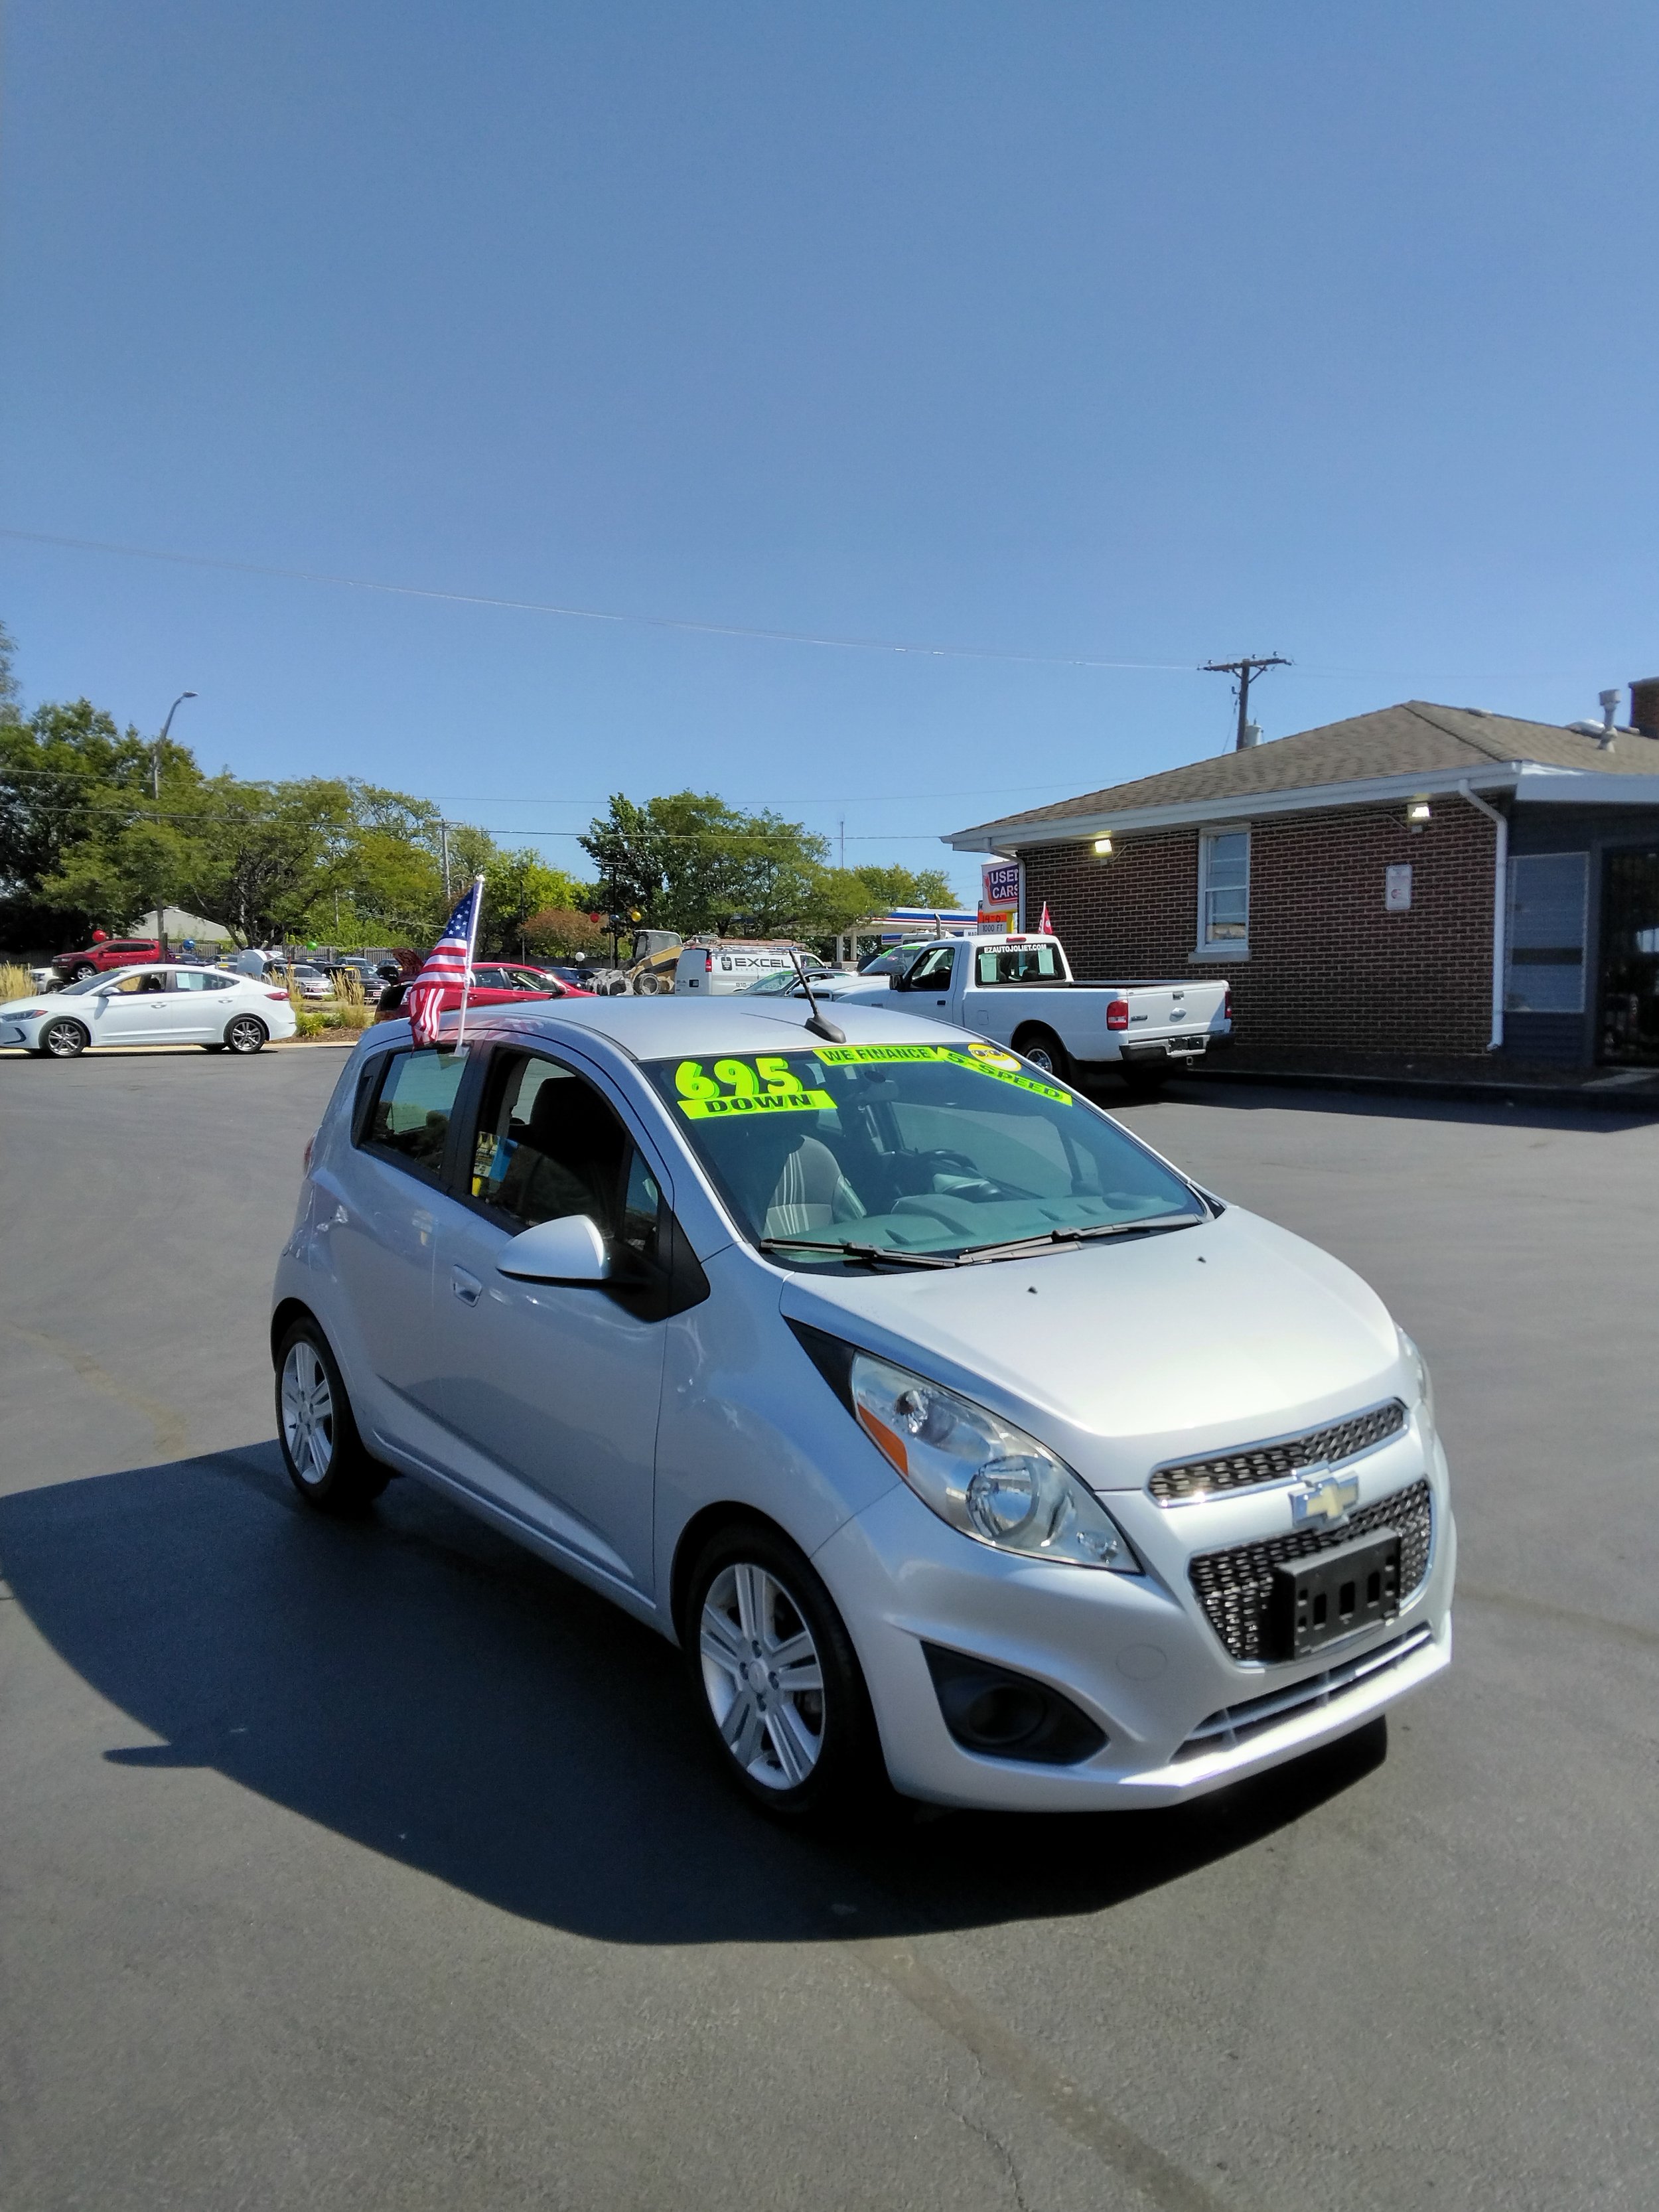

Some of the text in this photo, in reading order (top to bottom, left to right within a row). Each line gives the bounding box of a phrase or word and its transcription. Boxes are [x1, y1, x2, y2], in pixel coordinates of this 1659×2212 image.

[983, 944, 1046, 954] EZAUTOJOLIET.COM
[734, 958, 791, 968] EXCEL
[822, 1047, 931, 1062] WE FINANCE
[675, 1057, 803, 1100] 695
[946, 1051, 1060, 1099] 5-SPEED
[704, 1094, 815, 1113] DOWN
